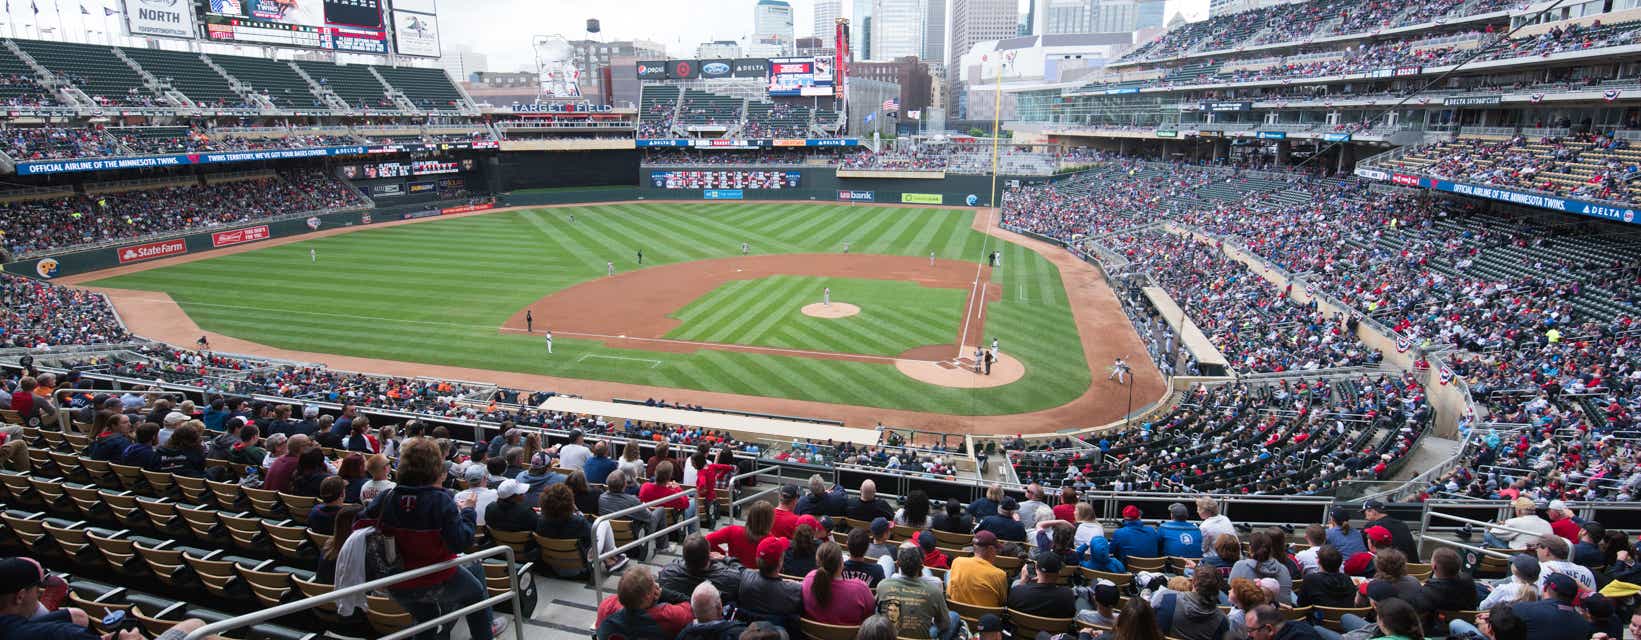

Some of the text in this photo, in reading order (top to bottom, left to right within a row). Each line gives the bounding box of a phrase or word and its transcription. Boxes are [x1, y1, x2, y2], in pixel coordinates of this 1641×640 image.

[139, 8, 180, 23] NORTH
[647, 66, 664, 74] pepsi
[512, 104, 613, 112] TARGET FIELD
[271, 151, 280, 159] GOT
[29, 157, 178, 173] OFFICIAL AIRLINE OF THE MINNESOTA TWINS.
[1453, 183, 1566, 210] OFFICIAL AIRLINE OF THE MINNESOTA TWINS.
[1591, 207, 1620, 218] DELTA
